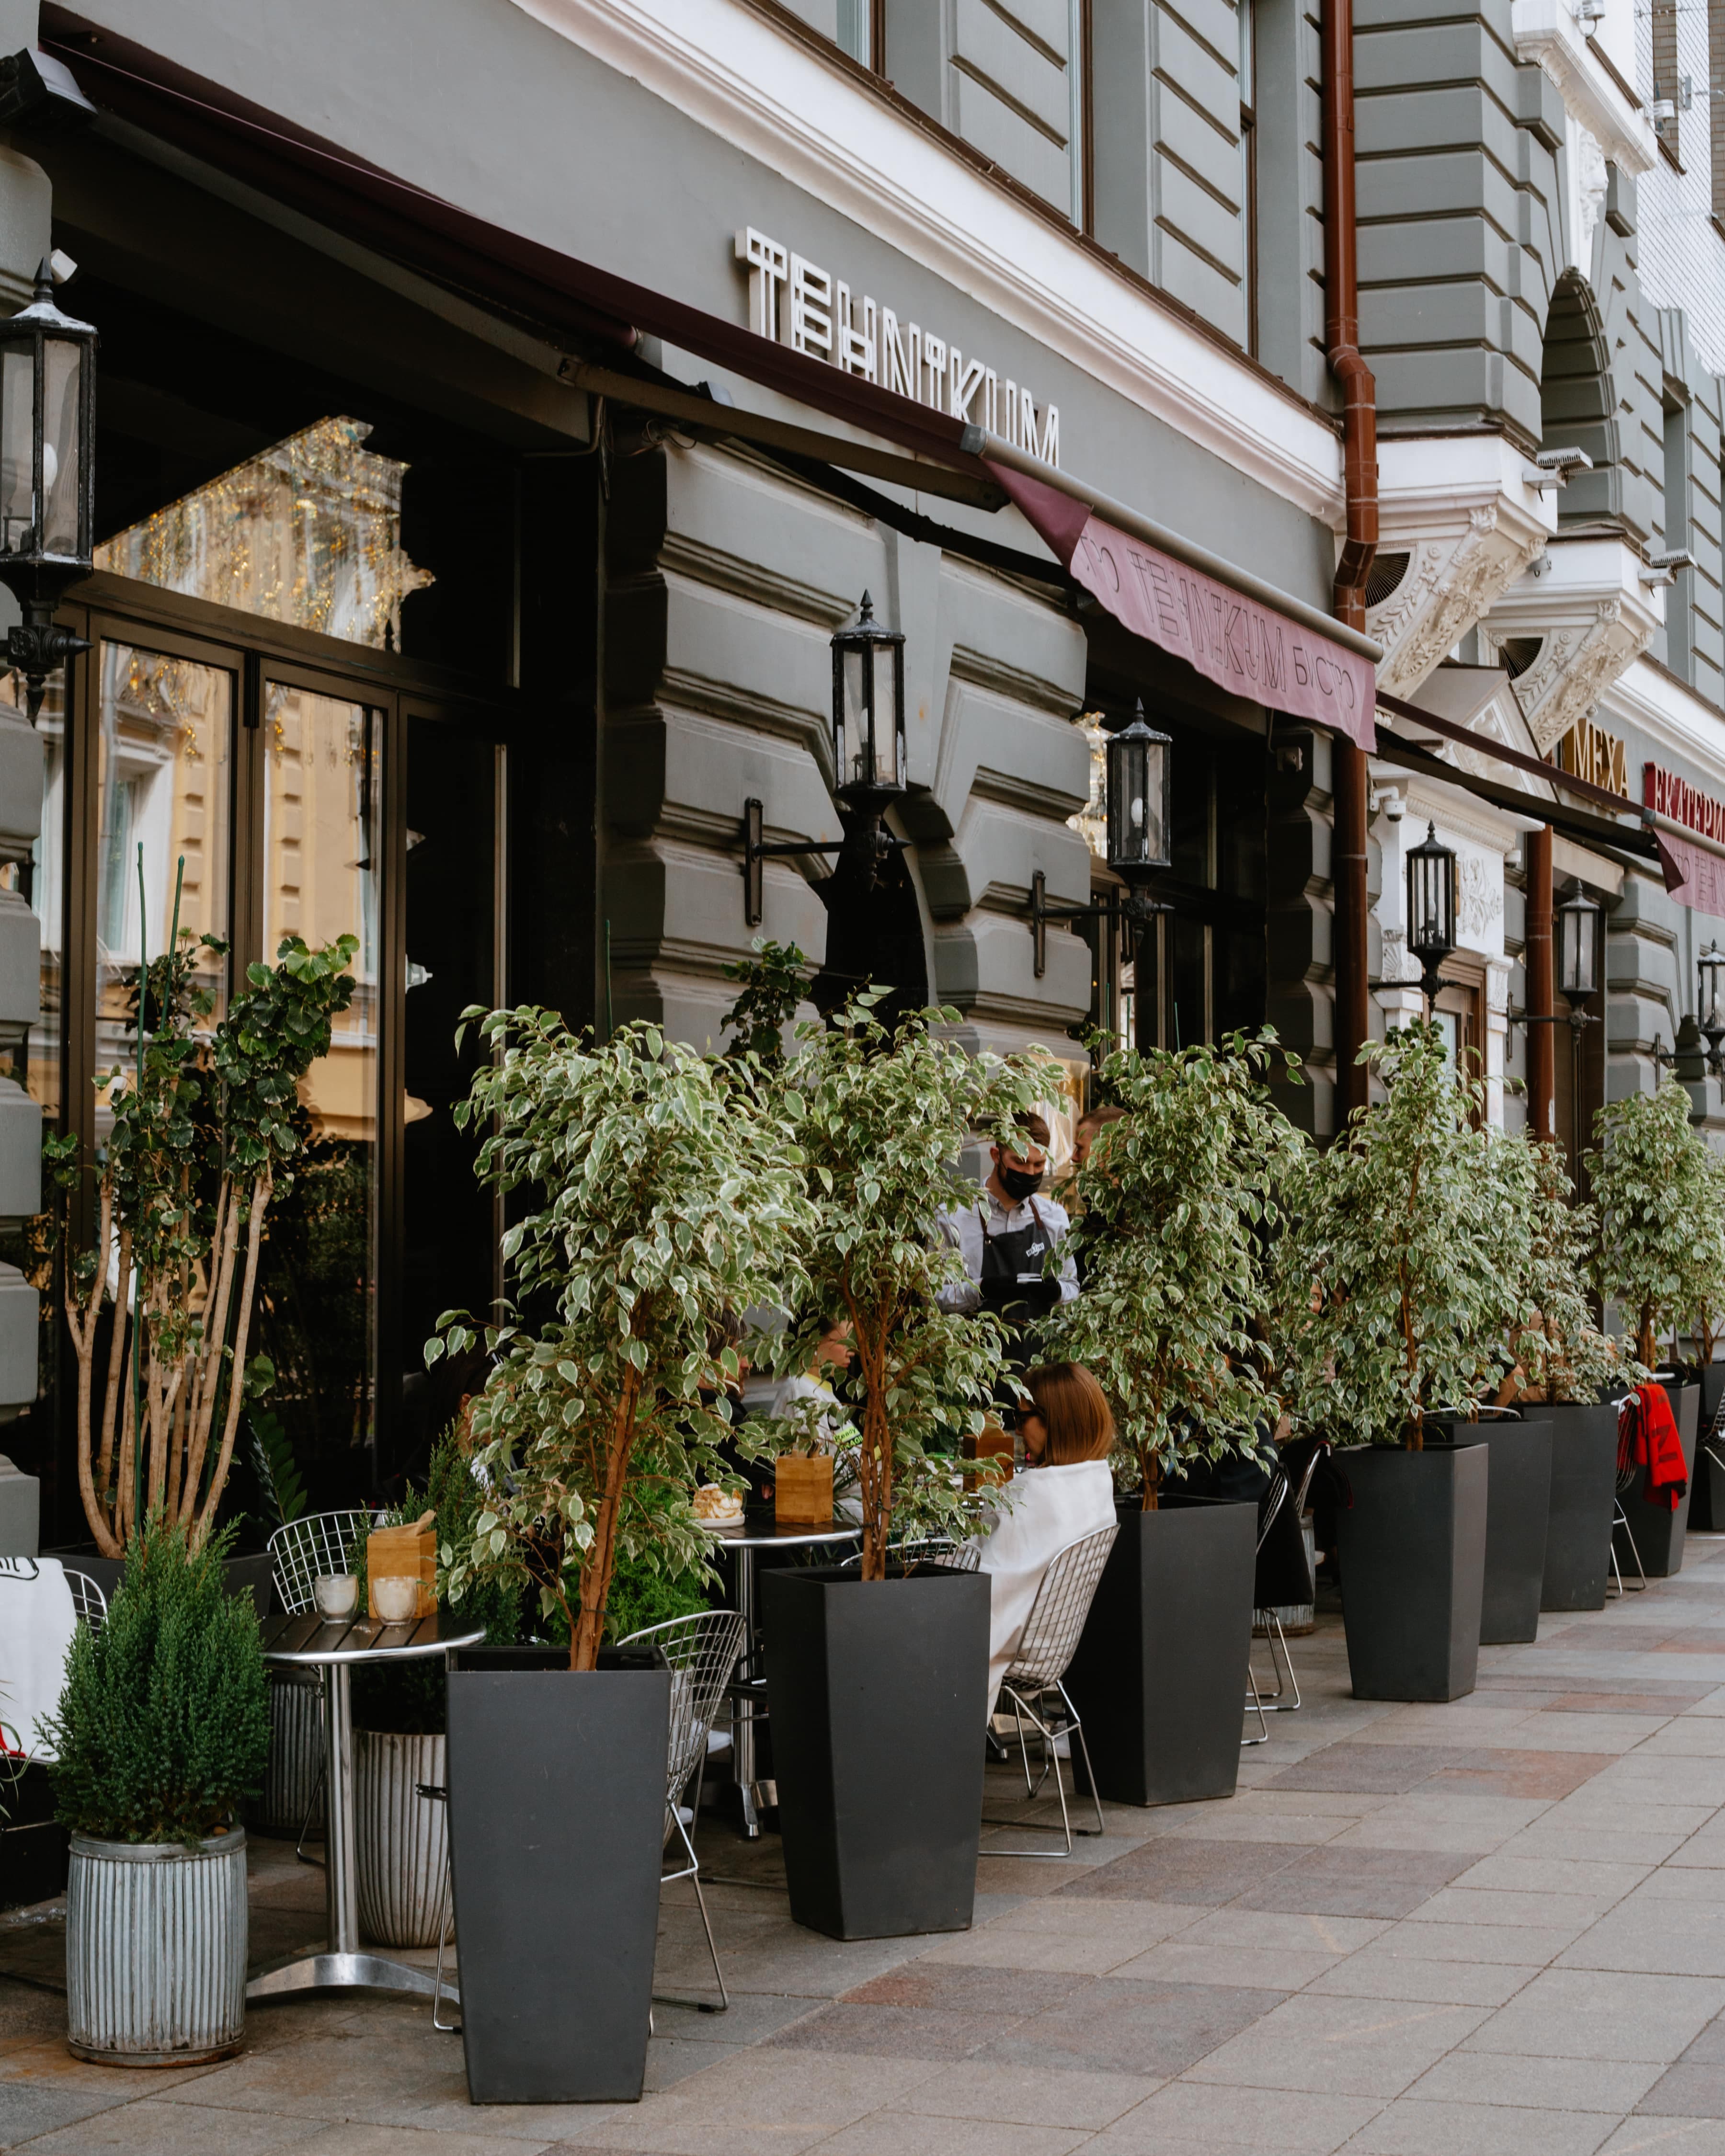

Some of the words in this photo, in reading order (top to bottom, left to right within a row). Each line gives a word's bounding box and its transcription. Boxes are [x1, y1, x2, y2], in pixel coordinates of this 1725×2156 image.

[735, 226, 1060, 469] TEHNIKUM
[1293, 646, 1354, 709] БИСТРО
[1572, 717, 1630, 799] МЕХА
[1653, 762, 1725, 844] ЕКАТЕРИ
